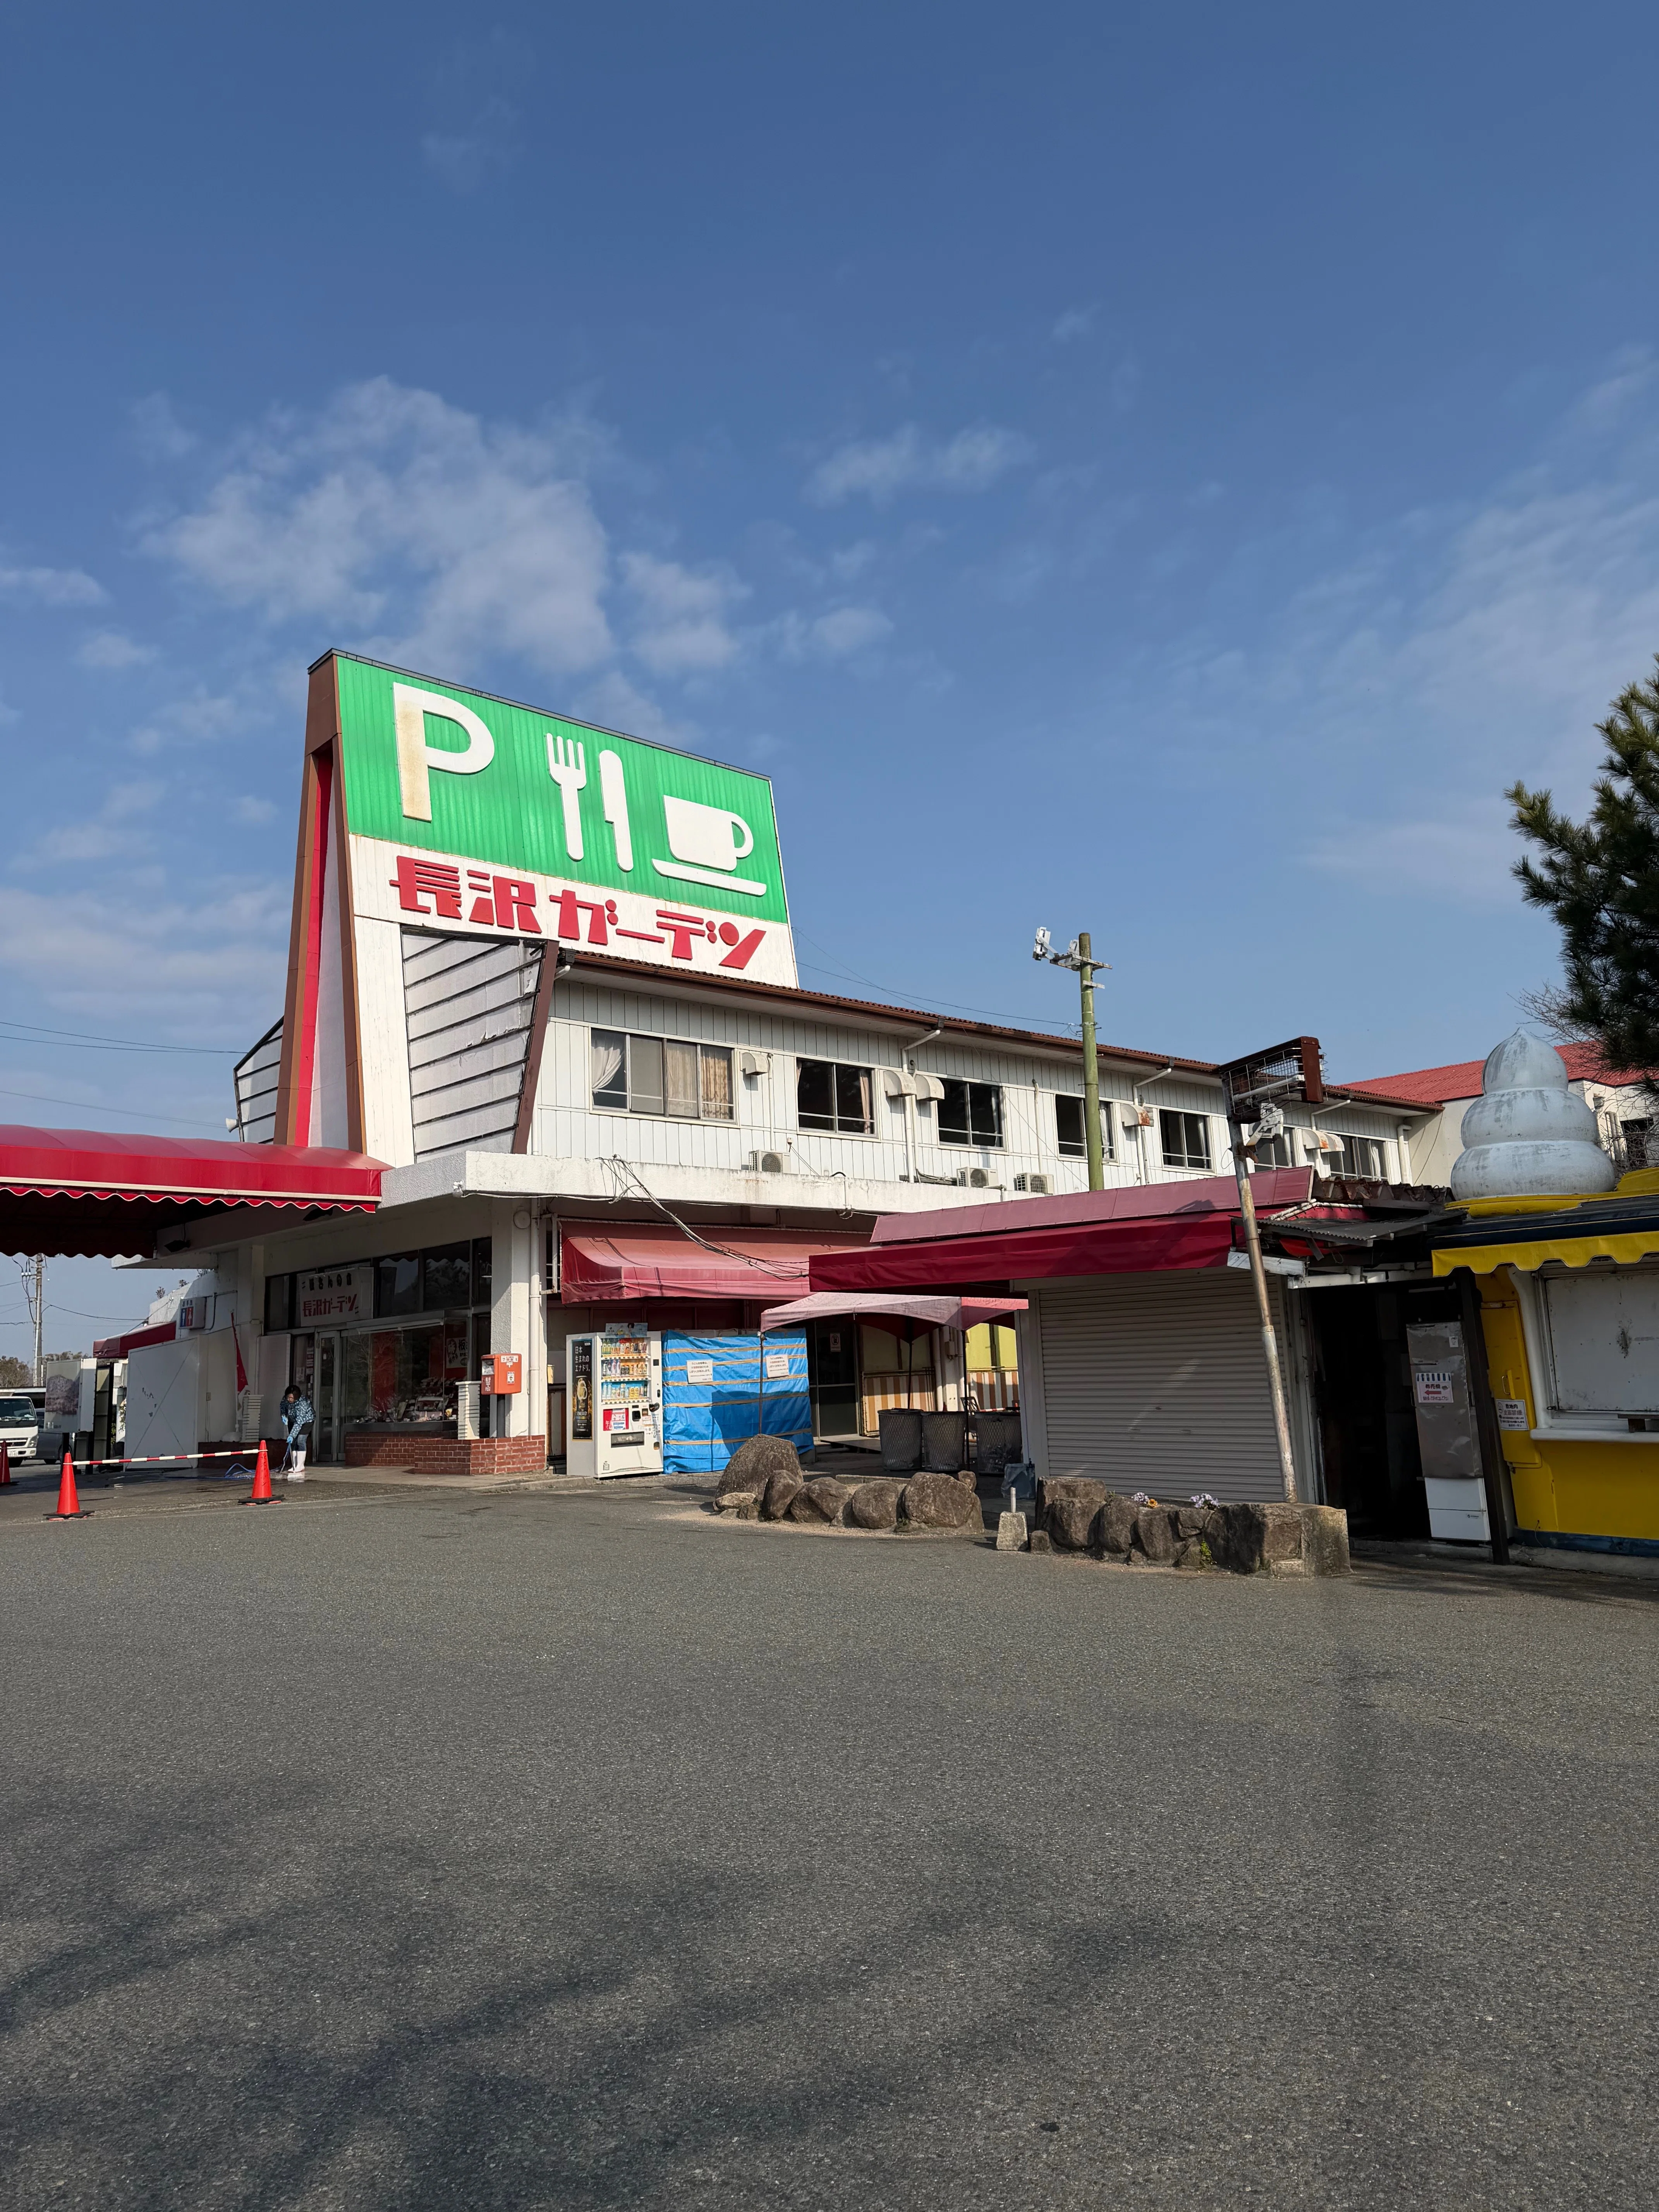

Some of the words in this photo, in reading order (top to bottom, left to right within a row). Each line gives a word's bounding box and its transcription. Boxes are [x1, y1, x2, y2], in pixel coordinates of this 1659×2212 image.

[393, 681, 495, 823] P
[389, 855, 766, 970] 長沢ガーデン
[575, 1355, 590, 1363] 生まれの
